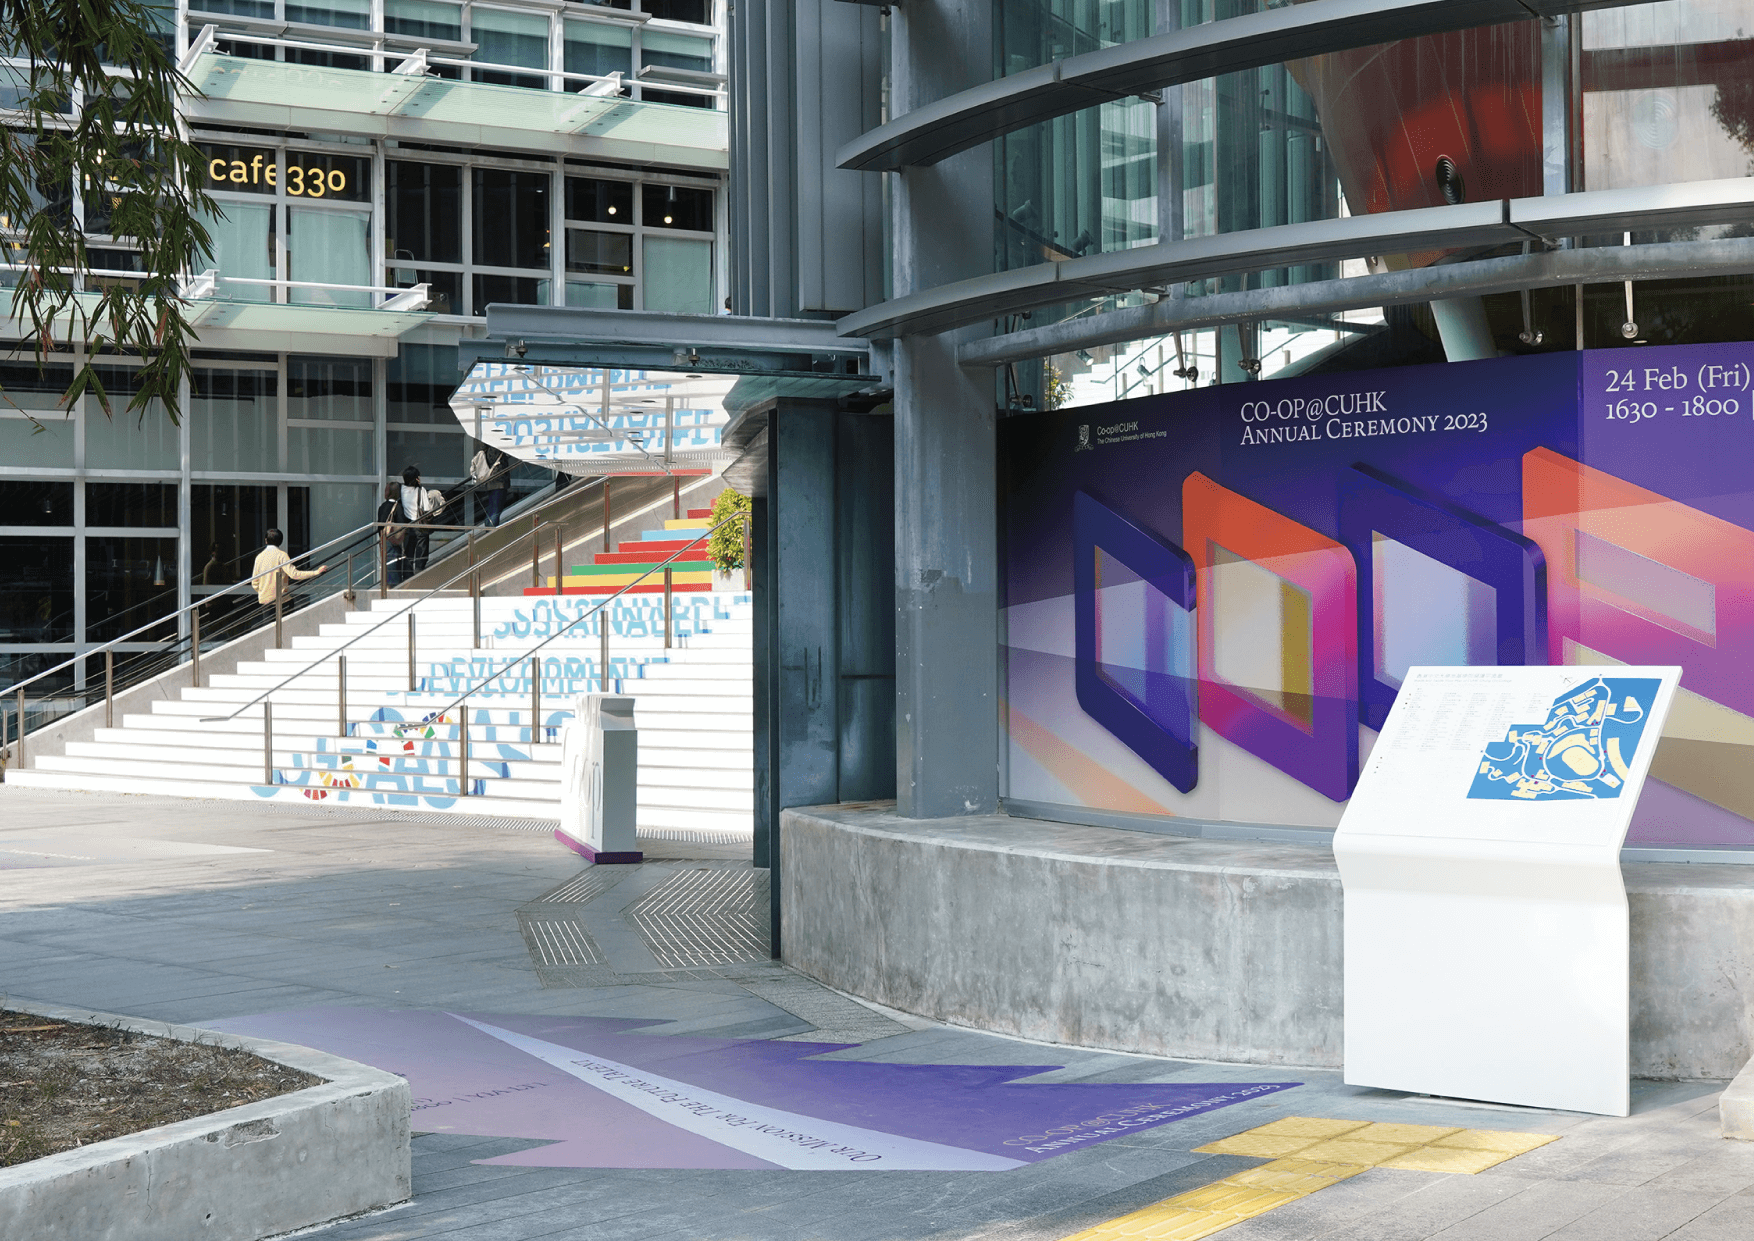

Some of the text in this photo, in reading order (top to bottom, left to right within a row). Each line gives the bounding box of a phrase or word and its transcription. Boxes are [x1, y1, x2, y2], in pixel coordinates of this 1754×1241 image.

[1605, 362, 1751, 394] 24 Feb (Fri)
[1240, 390, 1387, 423] CO-OP@CUHK
[1605, 398, 1658, 424] 1630
[1681, 395, 1740, 417] 1800
[1096, 421, 1139, 436] Co-op@CUHK
[1104, 436, 1120, 444] Chinese
[1120, 433, 1139, 442] University
[1144, 431, 1156, 439] Hong
[1156, 430, 1168, 438] Kong
[1240, 412, 1489, 446] ANNUAL CEREMONY 2023
